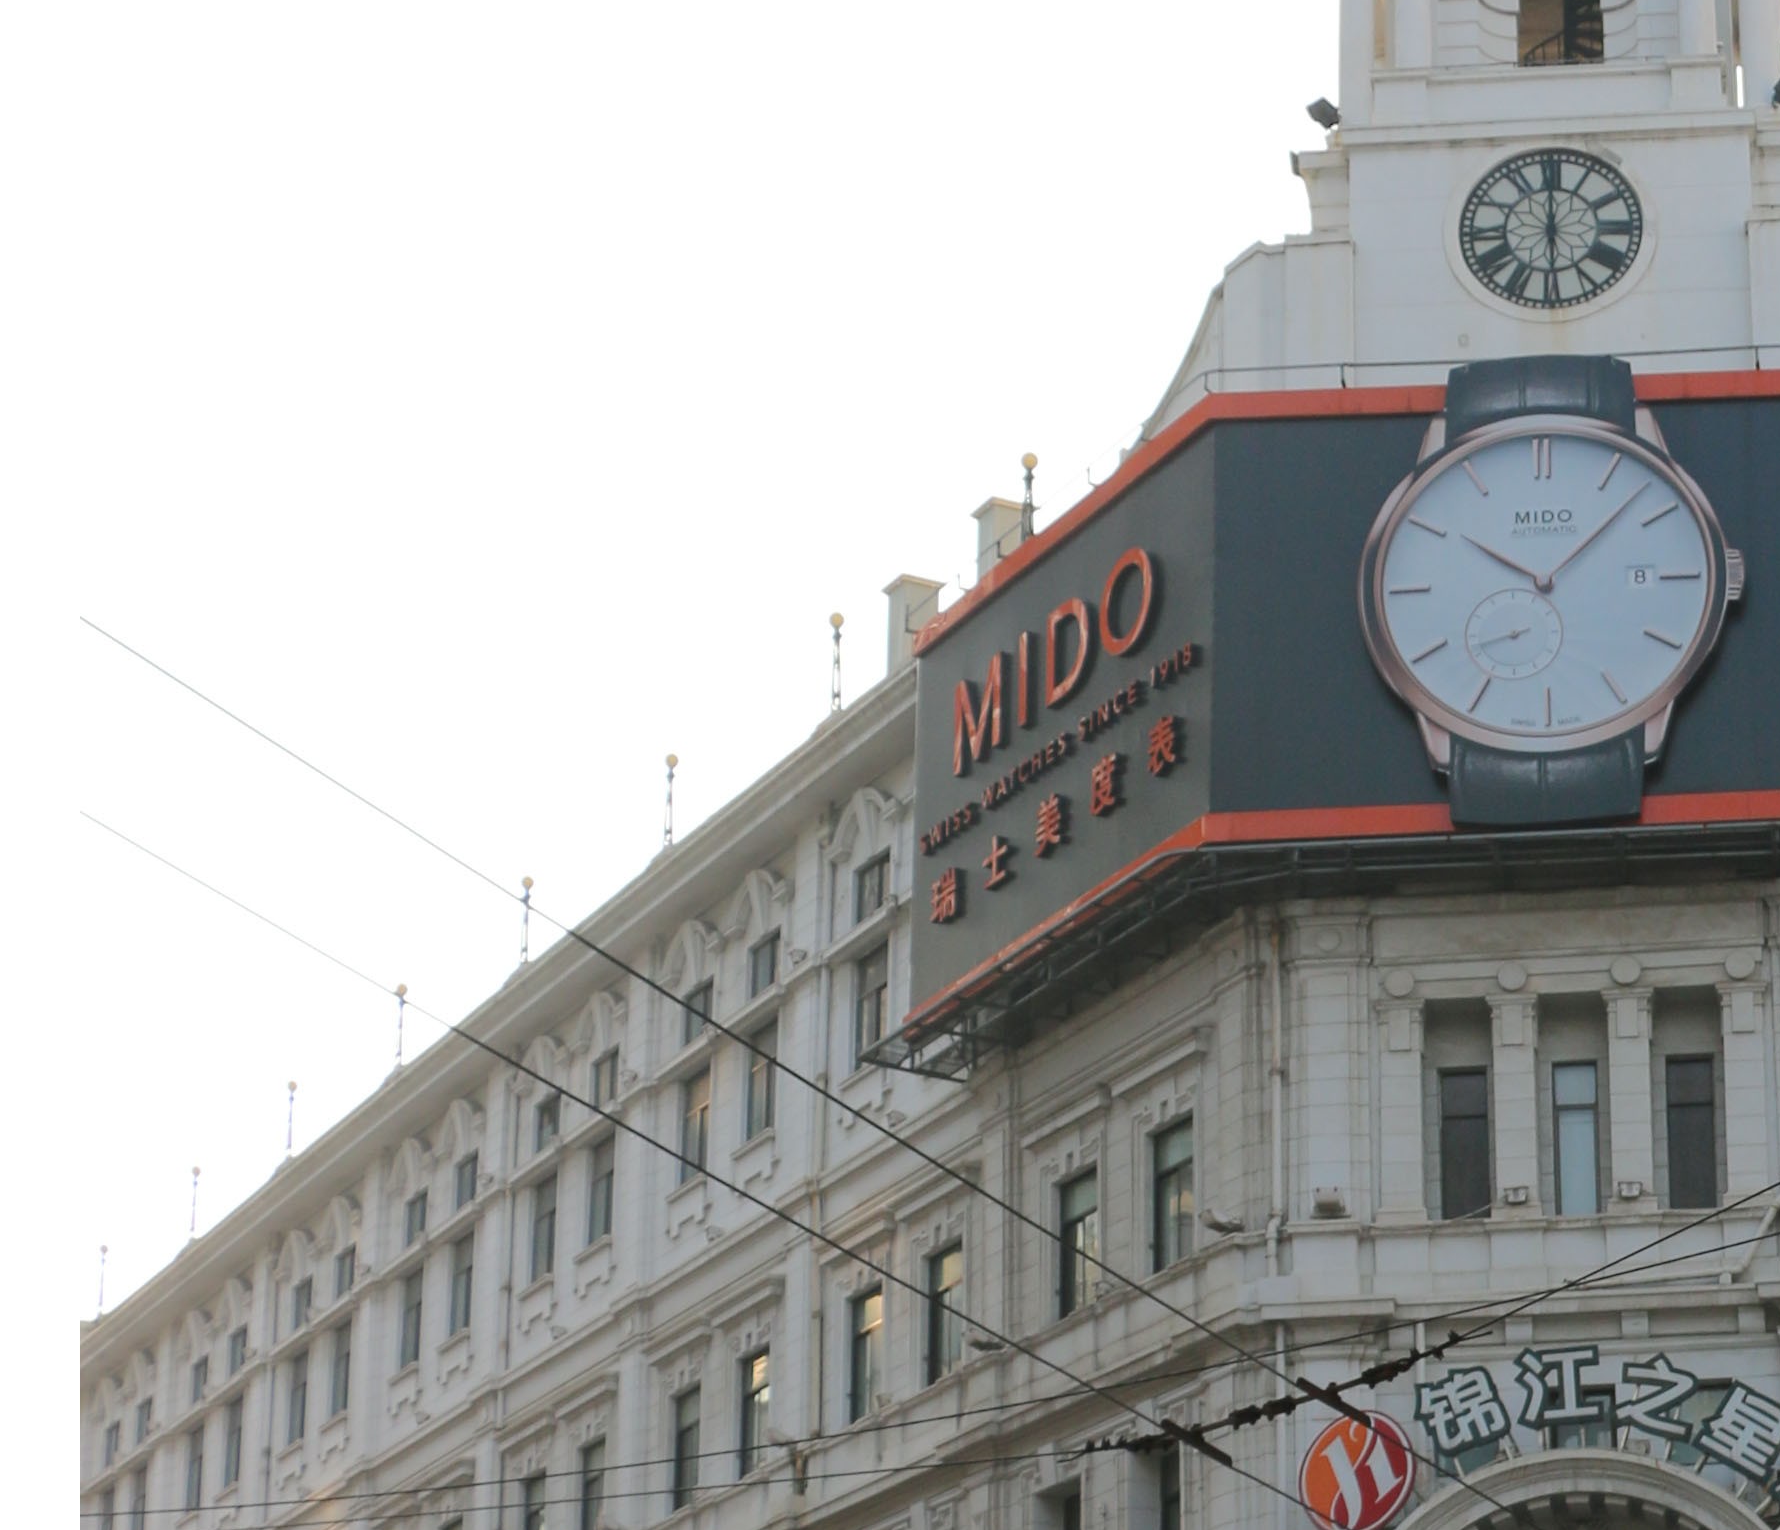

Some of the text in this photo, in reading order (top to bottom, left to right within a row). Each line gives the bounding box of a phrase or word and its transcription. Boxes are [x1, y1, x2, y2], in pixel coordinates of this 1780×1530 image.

[1514, 509, 1573, 524] MIDO
[1634, 569, 1646, 584] 8
[919, 642, 1194, 856] SWISS WATCHES SINCE 1918
[953, 547, 1153, 777] MIDO
[929, 715, 1177, 924] 瑞士美度表
